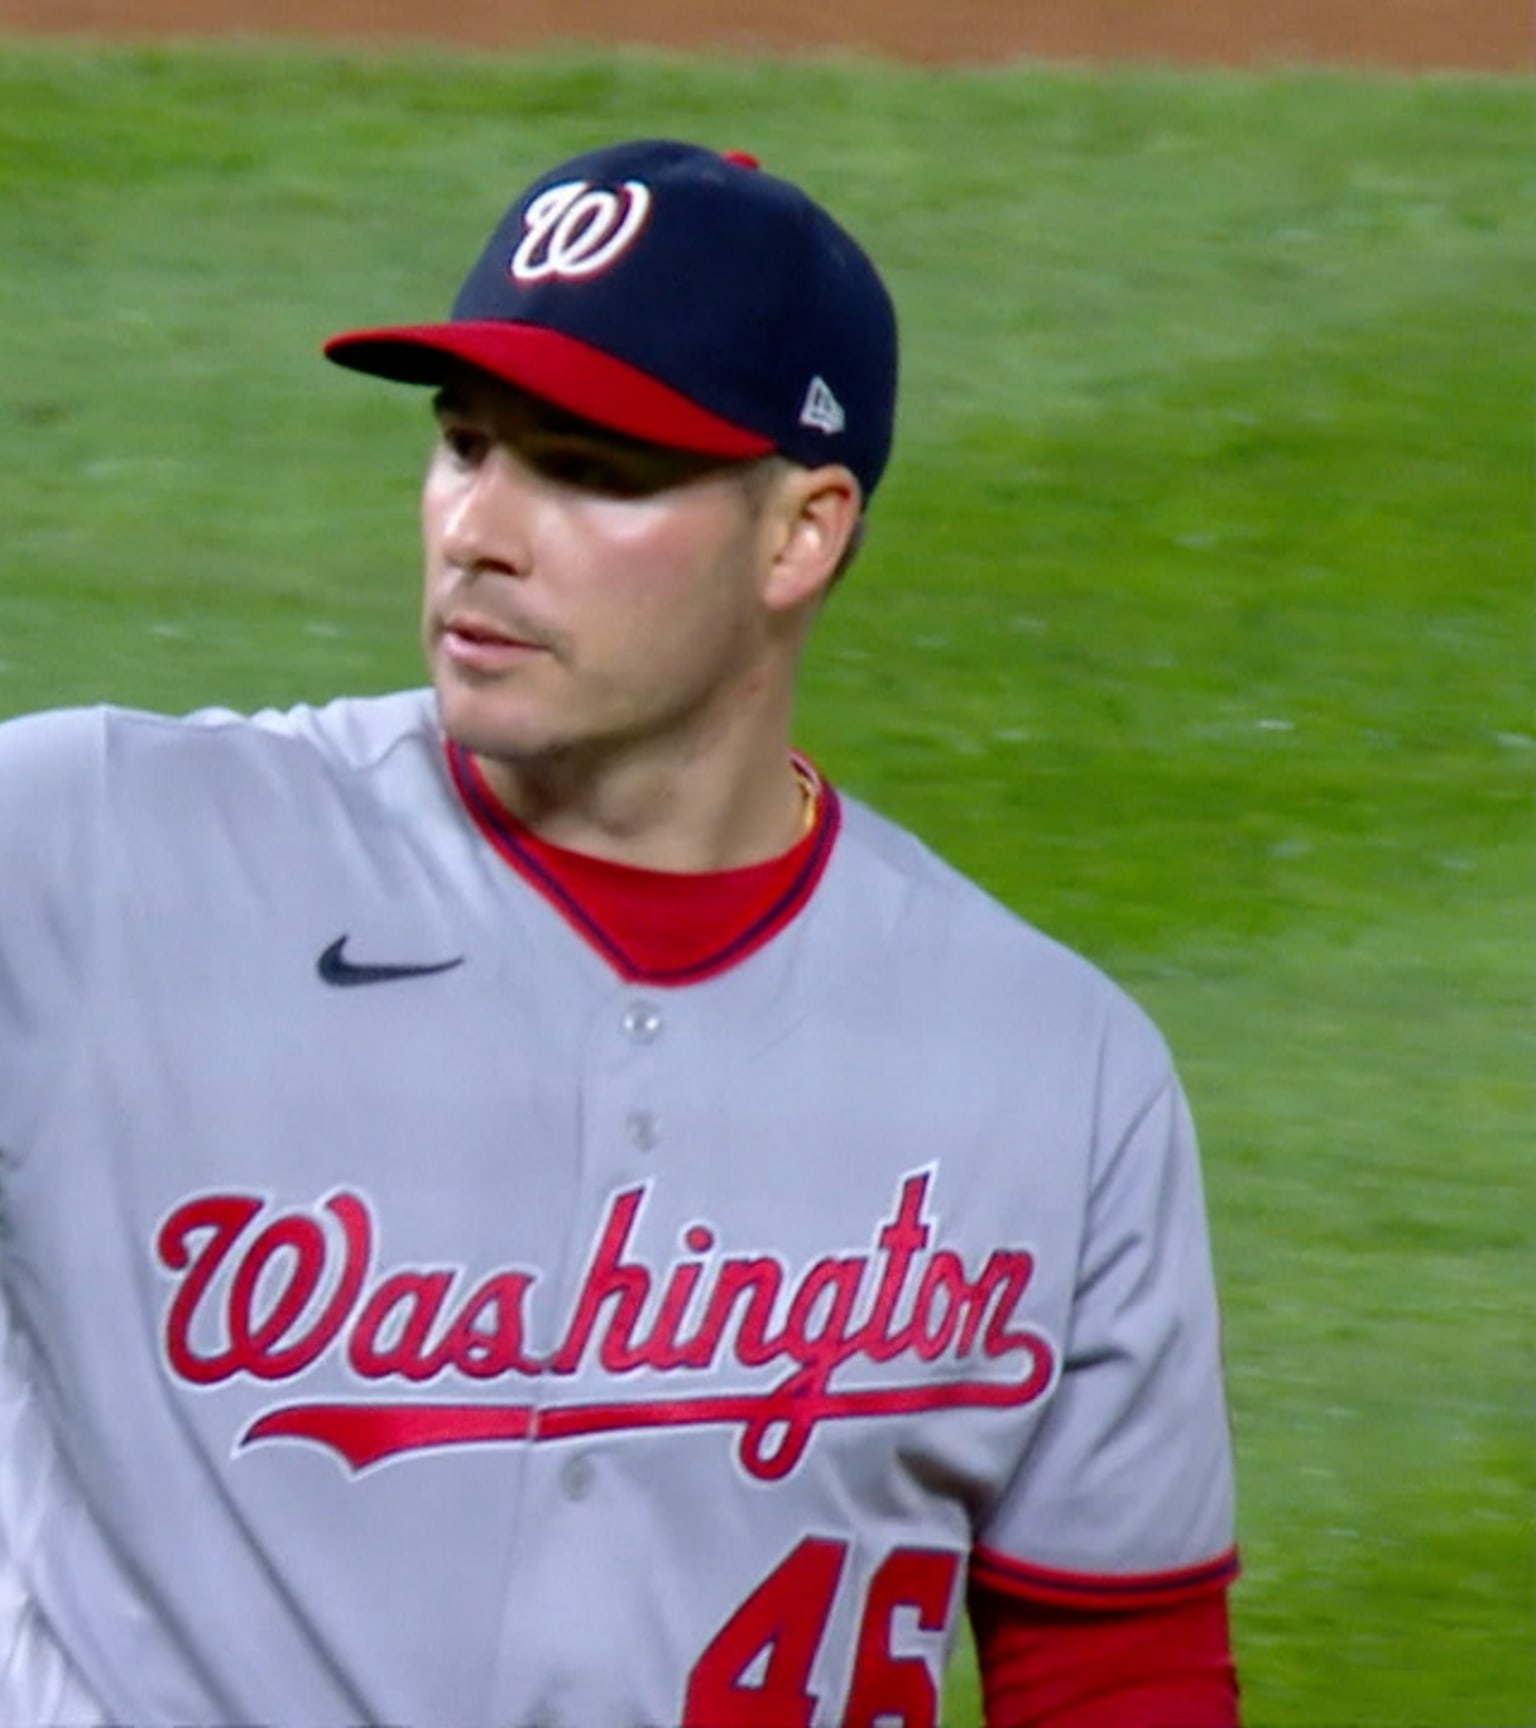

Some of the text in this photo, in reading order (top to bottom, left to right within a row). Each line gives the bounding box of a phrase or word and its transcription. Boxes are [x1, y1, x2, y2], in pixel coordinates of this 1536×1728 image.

[507, 178, 652, 286] W
[155, 1160, 1060, 1484] Washington
[676, 1534, 971, 1728] 46
